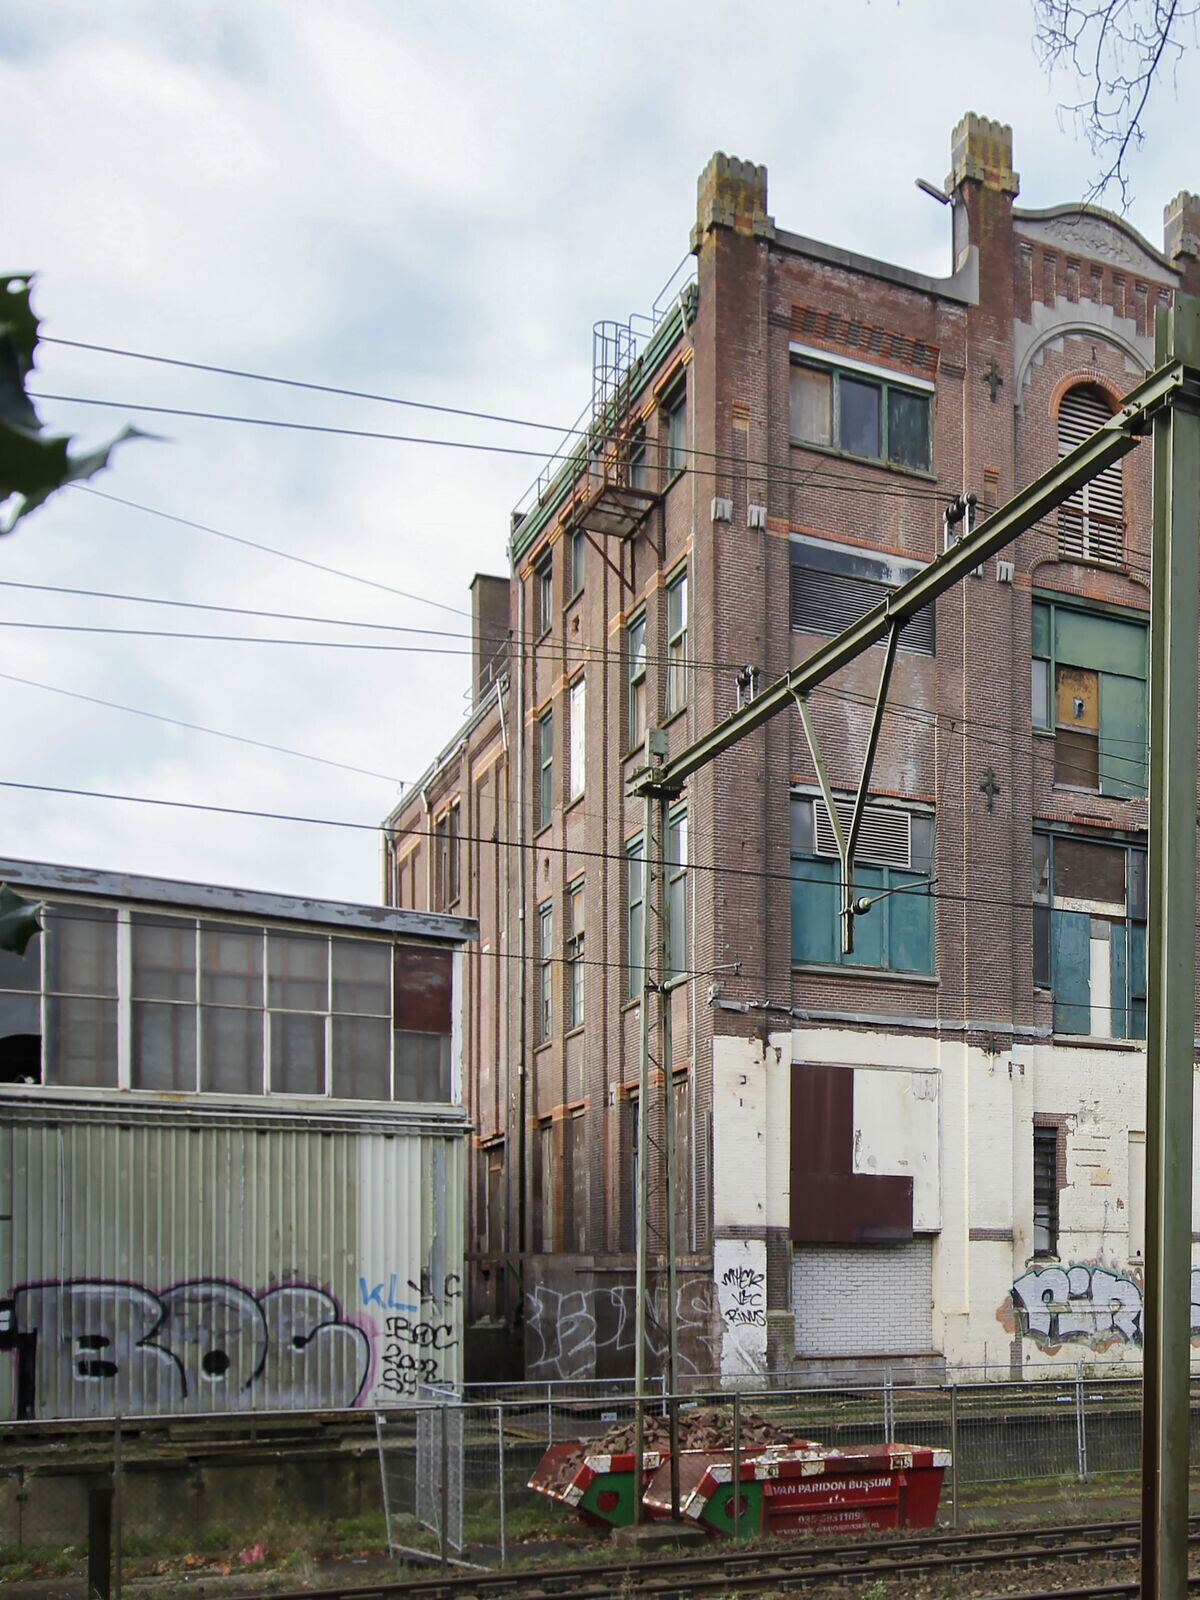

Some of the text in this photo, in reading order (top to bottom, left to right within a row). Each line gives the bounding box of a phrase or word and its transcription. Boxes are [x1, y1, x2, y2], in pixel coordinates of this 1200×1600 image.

[772, 1477, 892, 1495] VAN PARIDON BUSSUM
